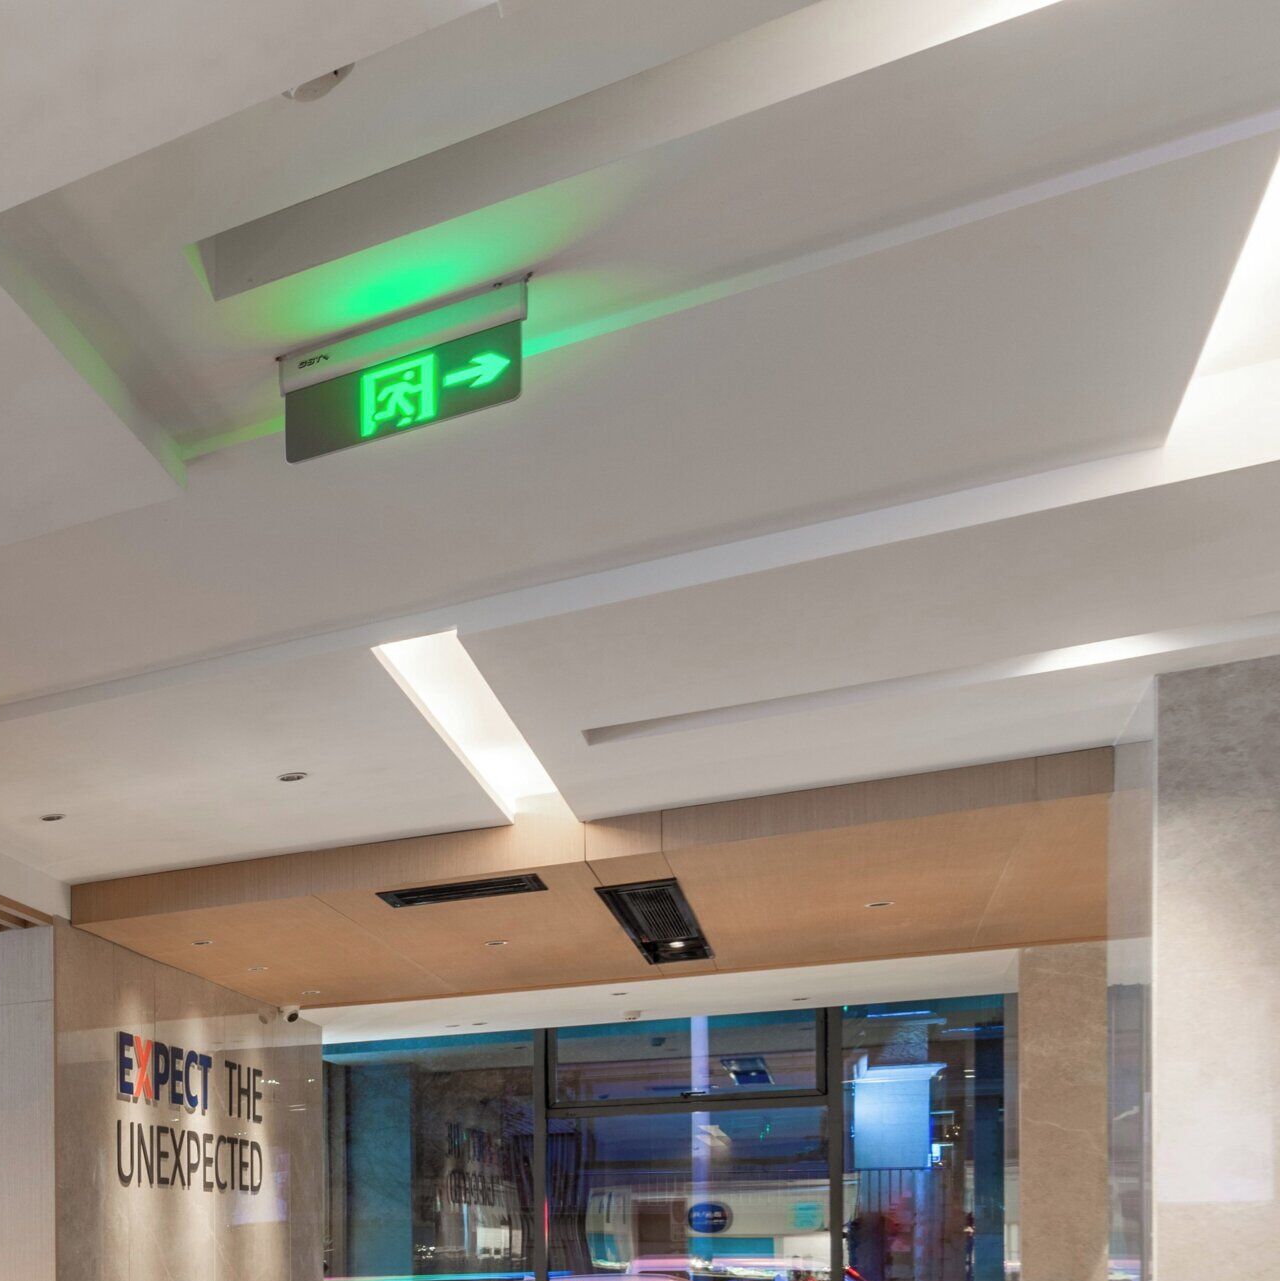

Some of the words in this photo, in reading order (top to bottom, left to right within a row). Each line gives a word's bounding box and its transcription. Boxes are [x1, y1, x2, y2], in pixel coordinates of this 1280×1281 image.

[118, 1031, 213, 1112] EXPECT
[225, 1060, 263, 1123] THE
[117, 1119, 263, 1194] UNEXPECTED
